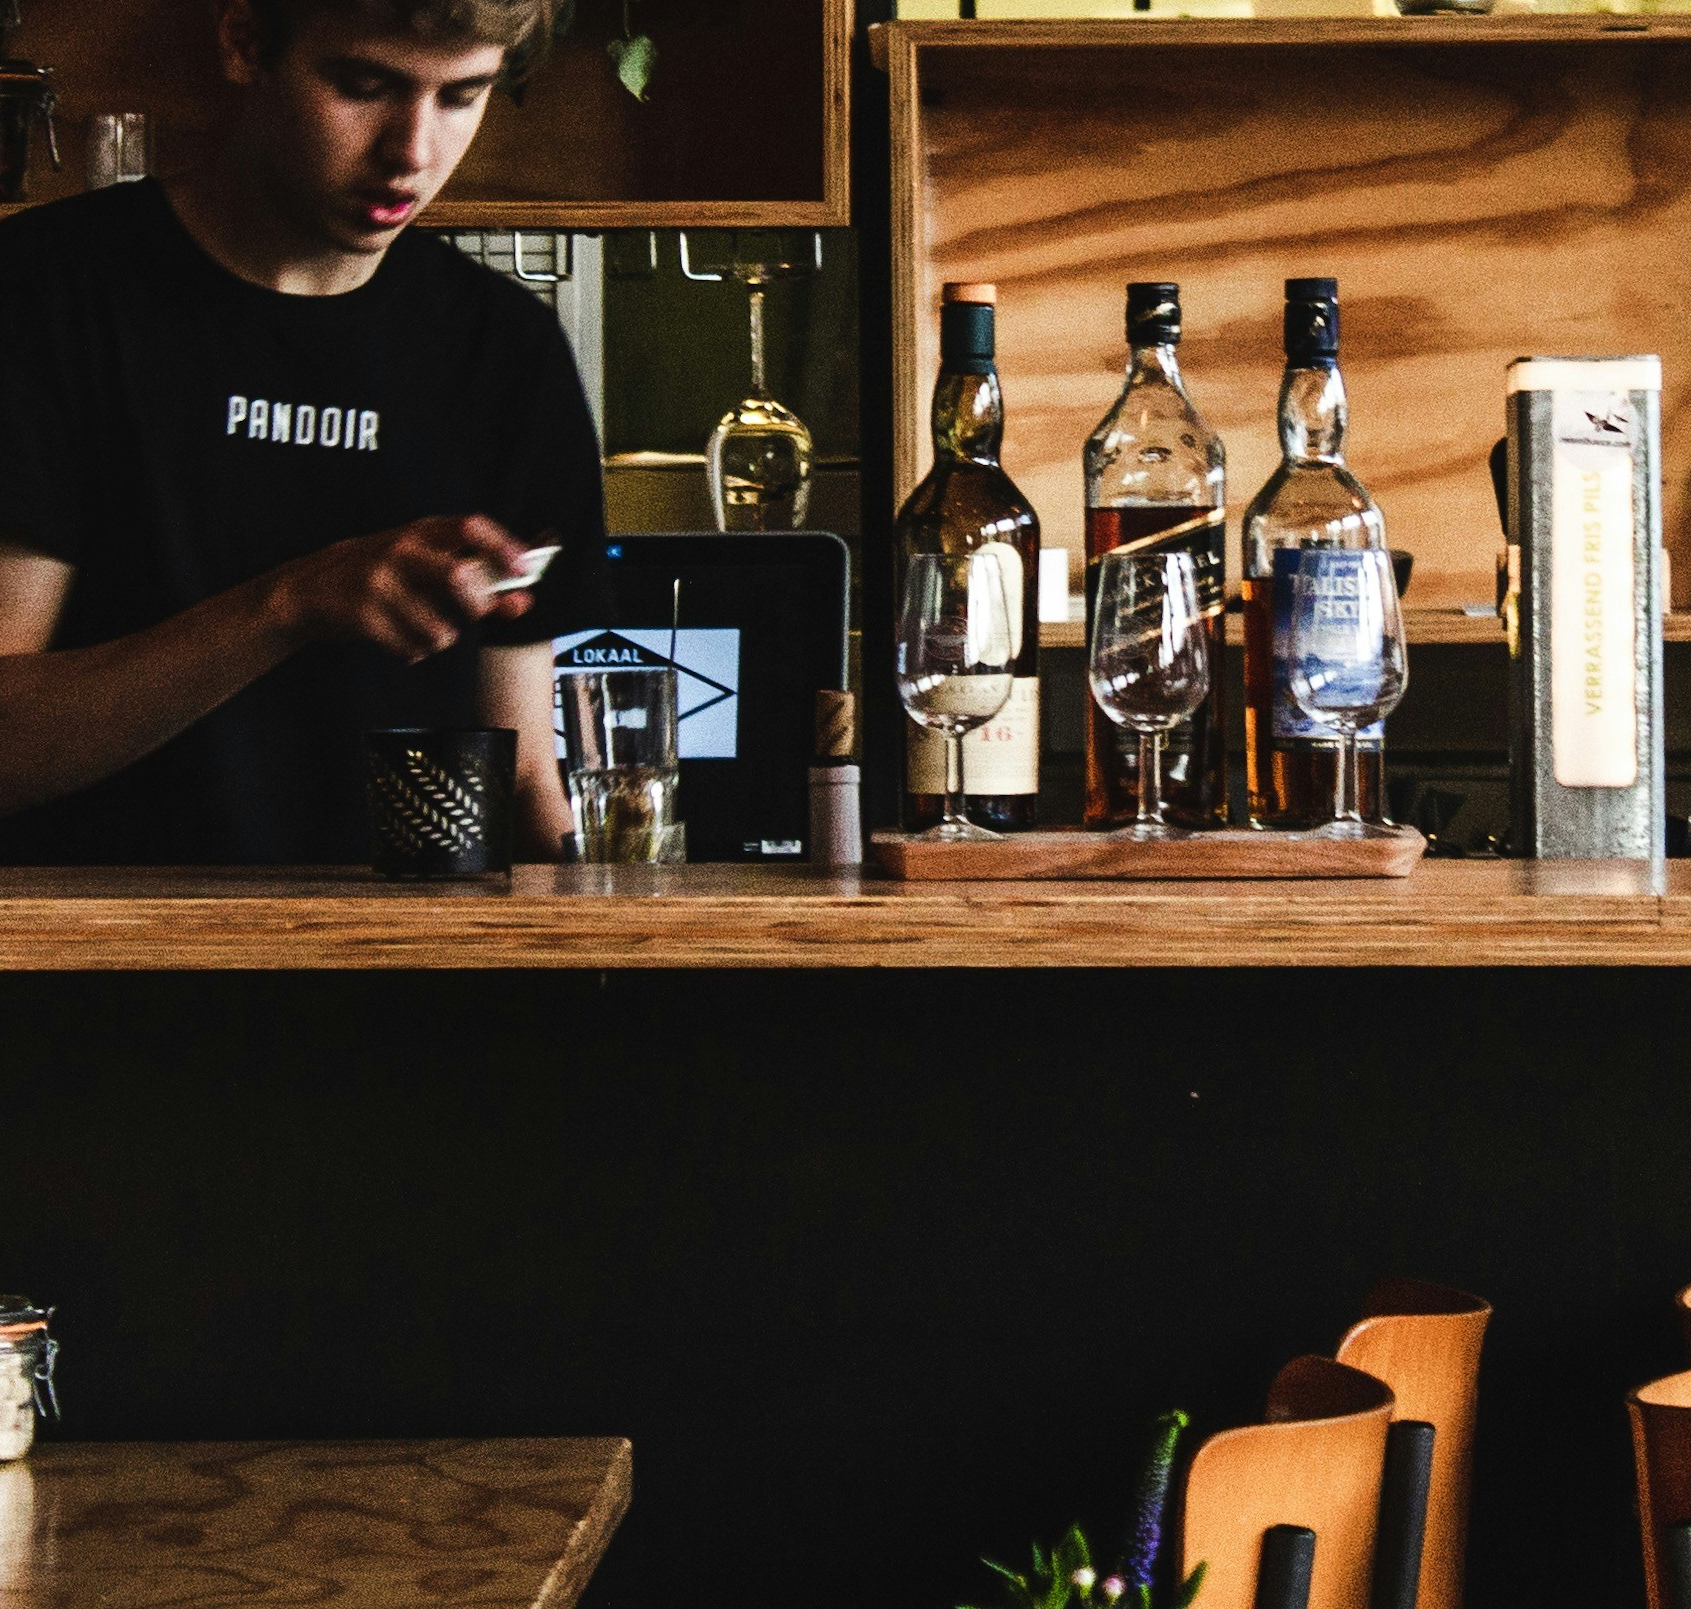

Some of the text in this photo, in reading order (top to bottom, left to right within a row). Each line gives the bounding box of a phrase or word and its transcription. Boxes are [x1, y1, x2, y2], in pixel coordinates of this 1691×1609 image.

[226, 394, 379, 452] PANDOIR
[1583, 469, 1603, 717] VERRASSEND FRIS PILS
[571, 648, 645, 664] LOKAAL
[979, 725, 1013, 743] 16
